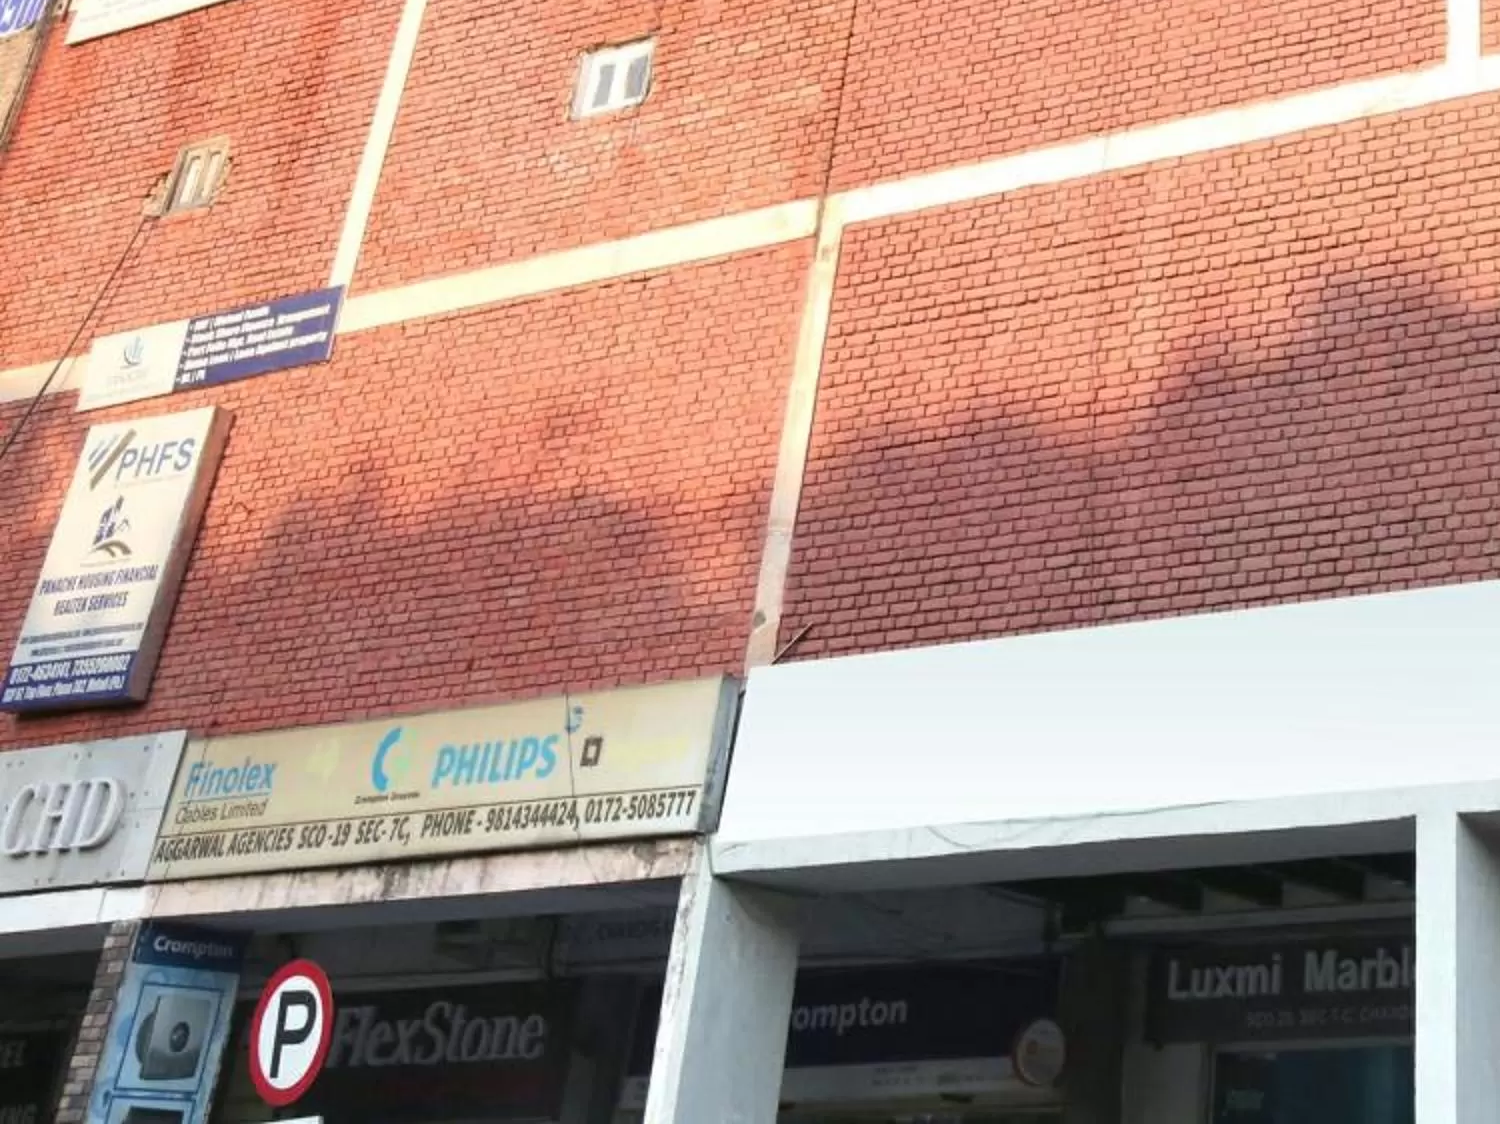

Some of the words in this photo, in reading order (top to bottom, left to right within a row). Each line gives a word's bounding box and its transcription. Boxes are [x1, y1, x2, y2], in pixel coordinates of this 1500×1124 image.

[116, 437, 195, 481] PHFS
[184, 761, 277, 798] Finolex
[432, 734, 560, 789] PHILIPS
[3, 777, 125, 856] CHD
[154, 835, 225, 863] AGGARWAL
[226, 827, 295, 856] AGENCIES
[585, 790, 698, 824] 0172-5085777
[175, 802, 217, 824] Cables
[220, 799, 268, 820] Limited
[1167, 952, 1282, 1000] Luxmi
[1303, 945, 1414, 993] Marbl
[269, 990, 317, 1079] P
[326, 1001, 545, 1068] FlexStone
[792, 996, 908, 1035] ompton
